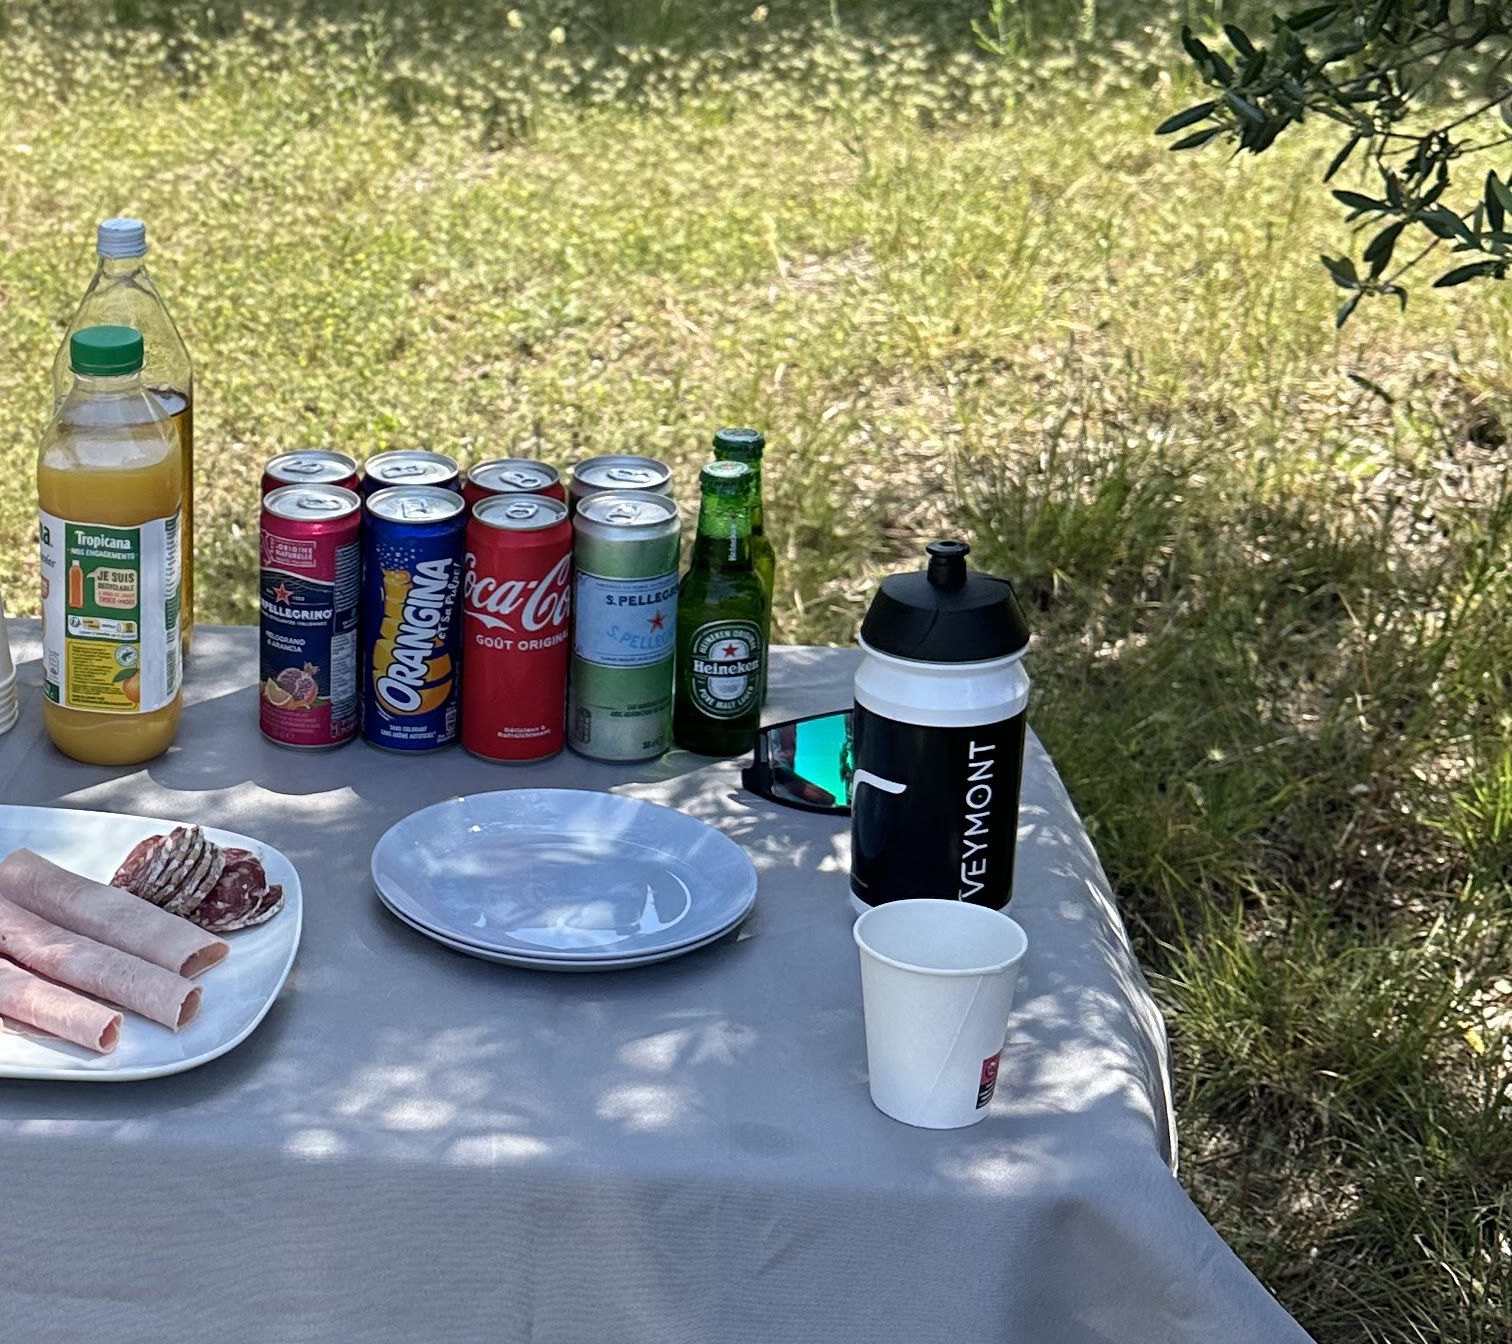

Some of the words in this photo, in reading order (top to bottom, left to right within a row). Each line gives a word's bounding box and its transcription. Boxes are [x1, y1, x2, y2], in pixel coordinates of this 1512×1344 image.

[74, 530, 132, 549] Tropicana
[86, 549, 136, 560] ENGAGEMENTS
[97, 571, 109, 582] JE
[111, 572, 135, 584] SUIS
[261, 598, 332, 620] PELLEGRINO
[377, 558, 453, 712] ORANGINA
[476, 634, 513, 650] GOÛT
[693, 659, 759, 675] Heineken
[958, 741, 996, 901] VEYMONT
